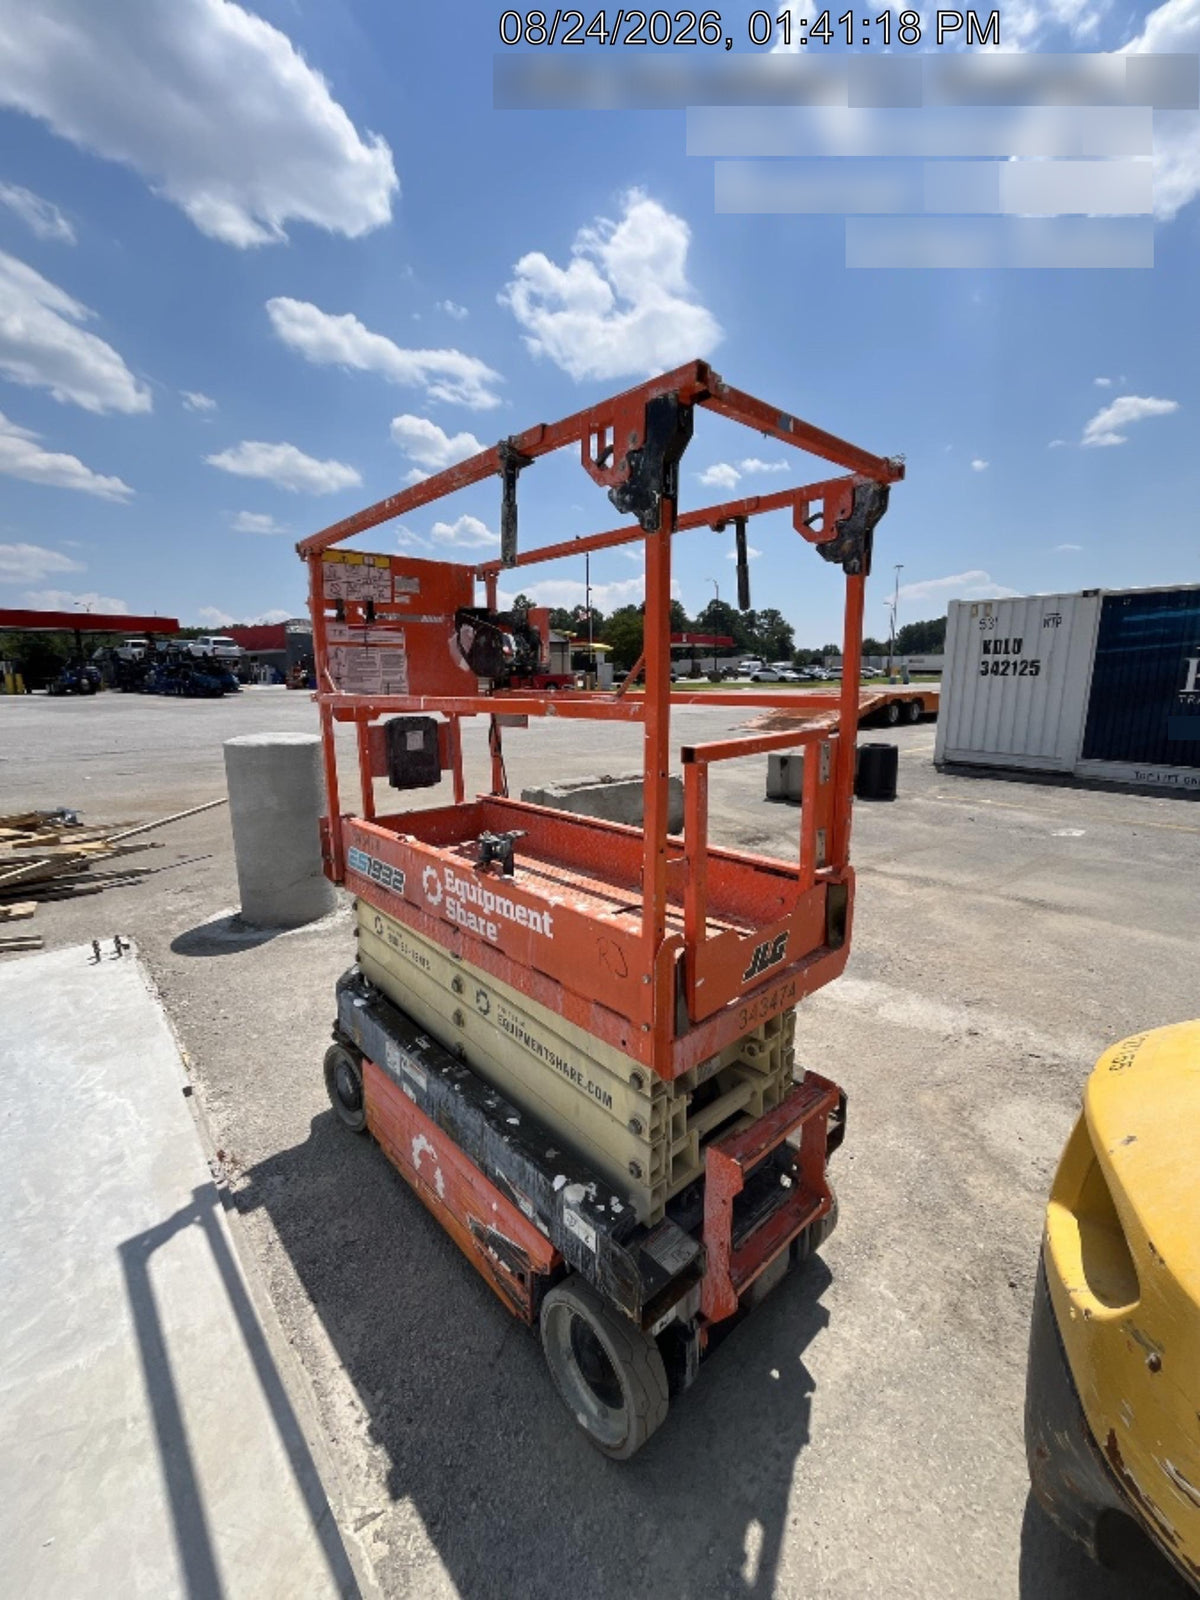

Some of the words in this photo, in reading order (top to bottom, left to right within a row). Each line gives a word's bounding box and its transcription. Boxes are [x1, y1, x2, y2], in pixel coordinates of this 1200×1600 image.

[980, 659, 1041, 676] 342125
[348, 847, 405, 894] ES1932
[443, 867, 554, 939] Equipment
[445, 897, 498, 942] Share
[742, 930, 790, 984] JLG
[498, 1013, 613, 1110] EQUIPMENTSHARE.COM
